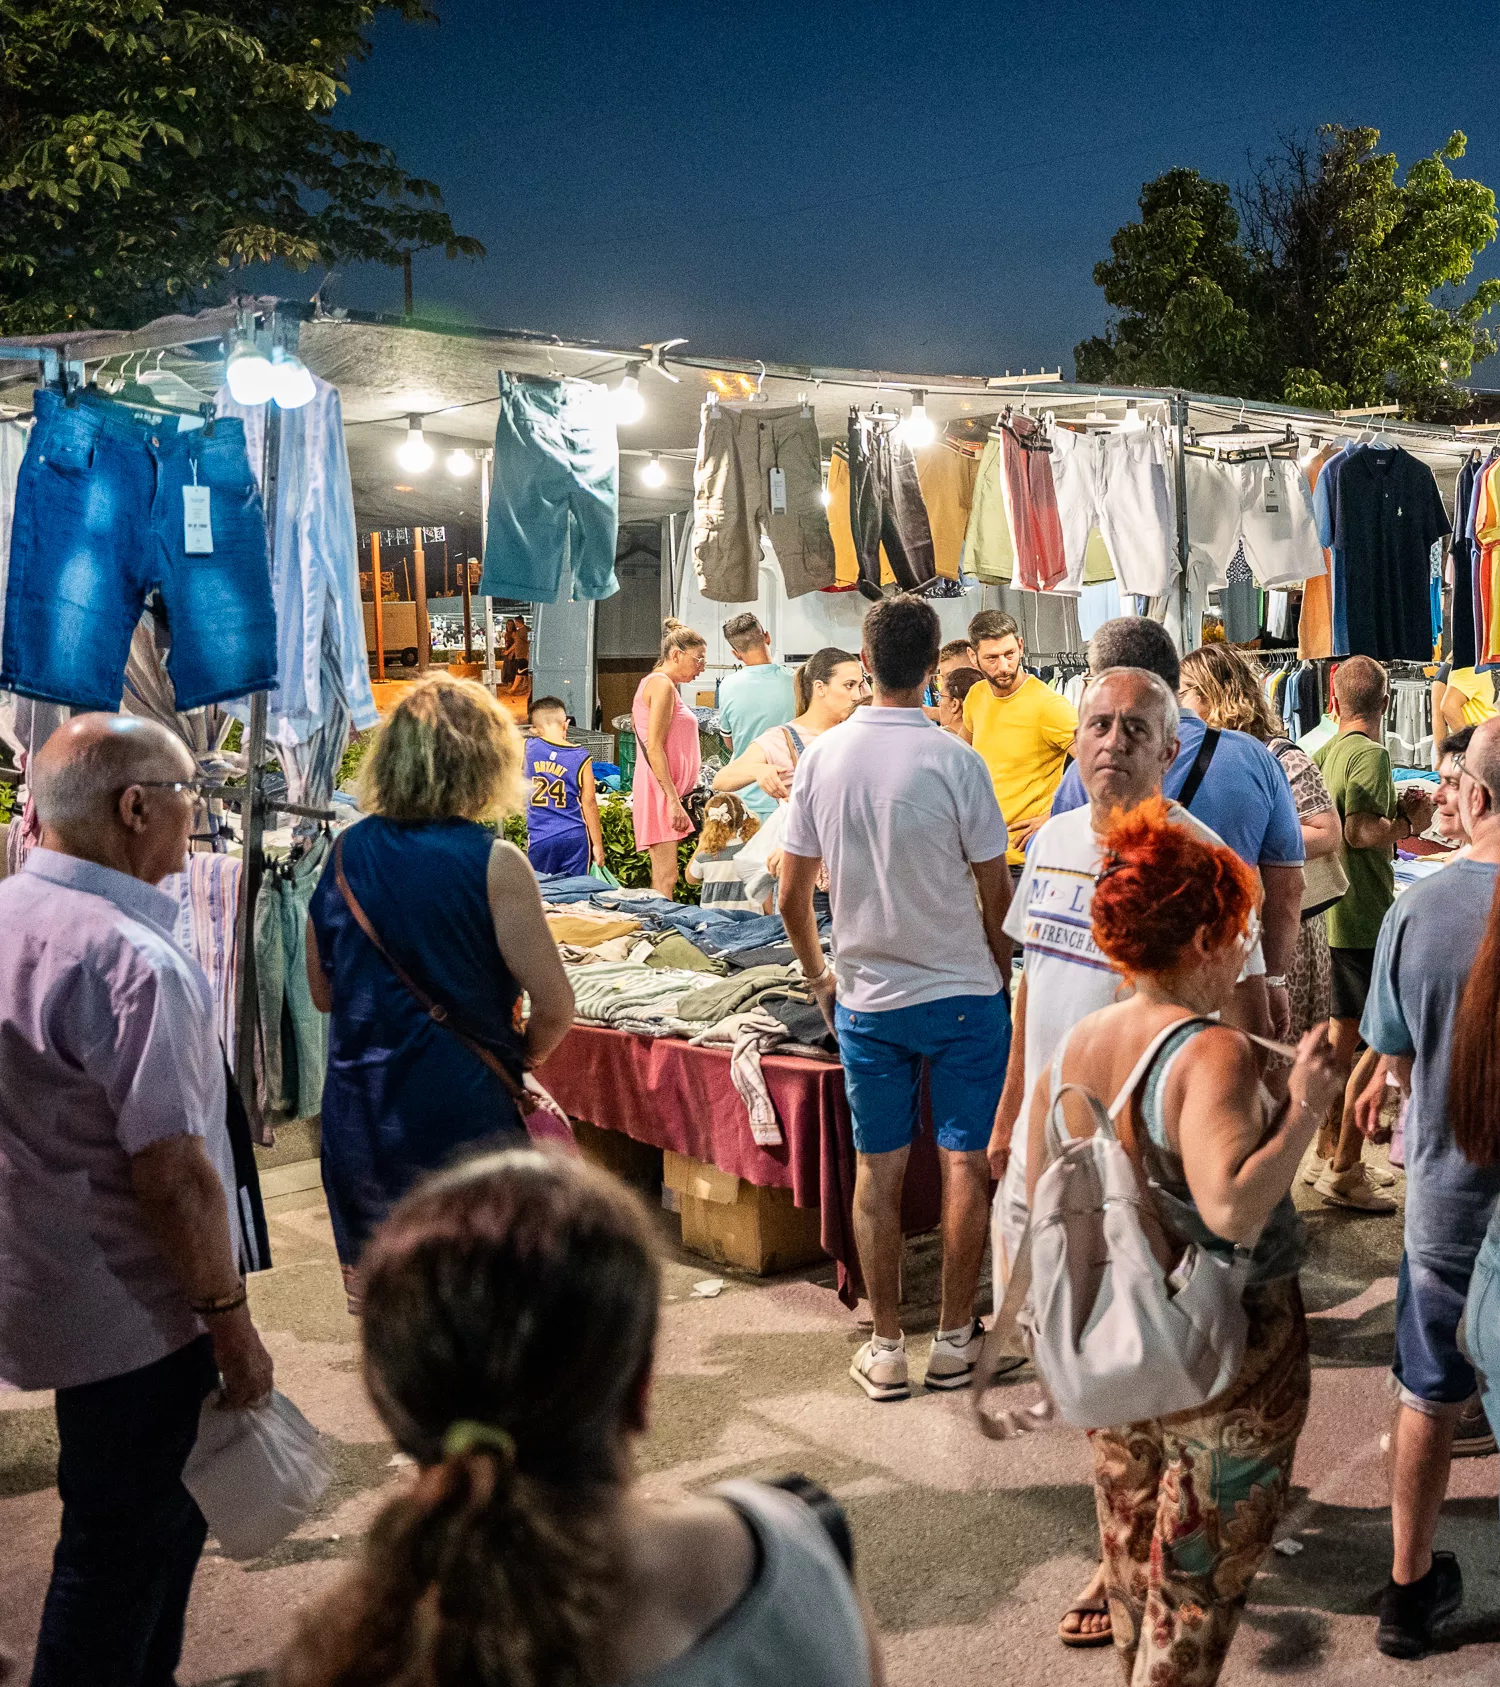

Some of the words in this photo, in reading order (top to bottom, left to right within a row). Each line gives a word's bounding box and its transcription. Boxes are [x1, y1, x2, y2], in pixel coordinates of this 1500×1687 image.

[533, 760, 568, 777] BRYANT
[531, 776, 567, 808] 24
[1041, 923, 1086, 950] FRENCH
